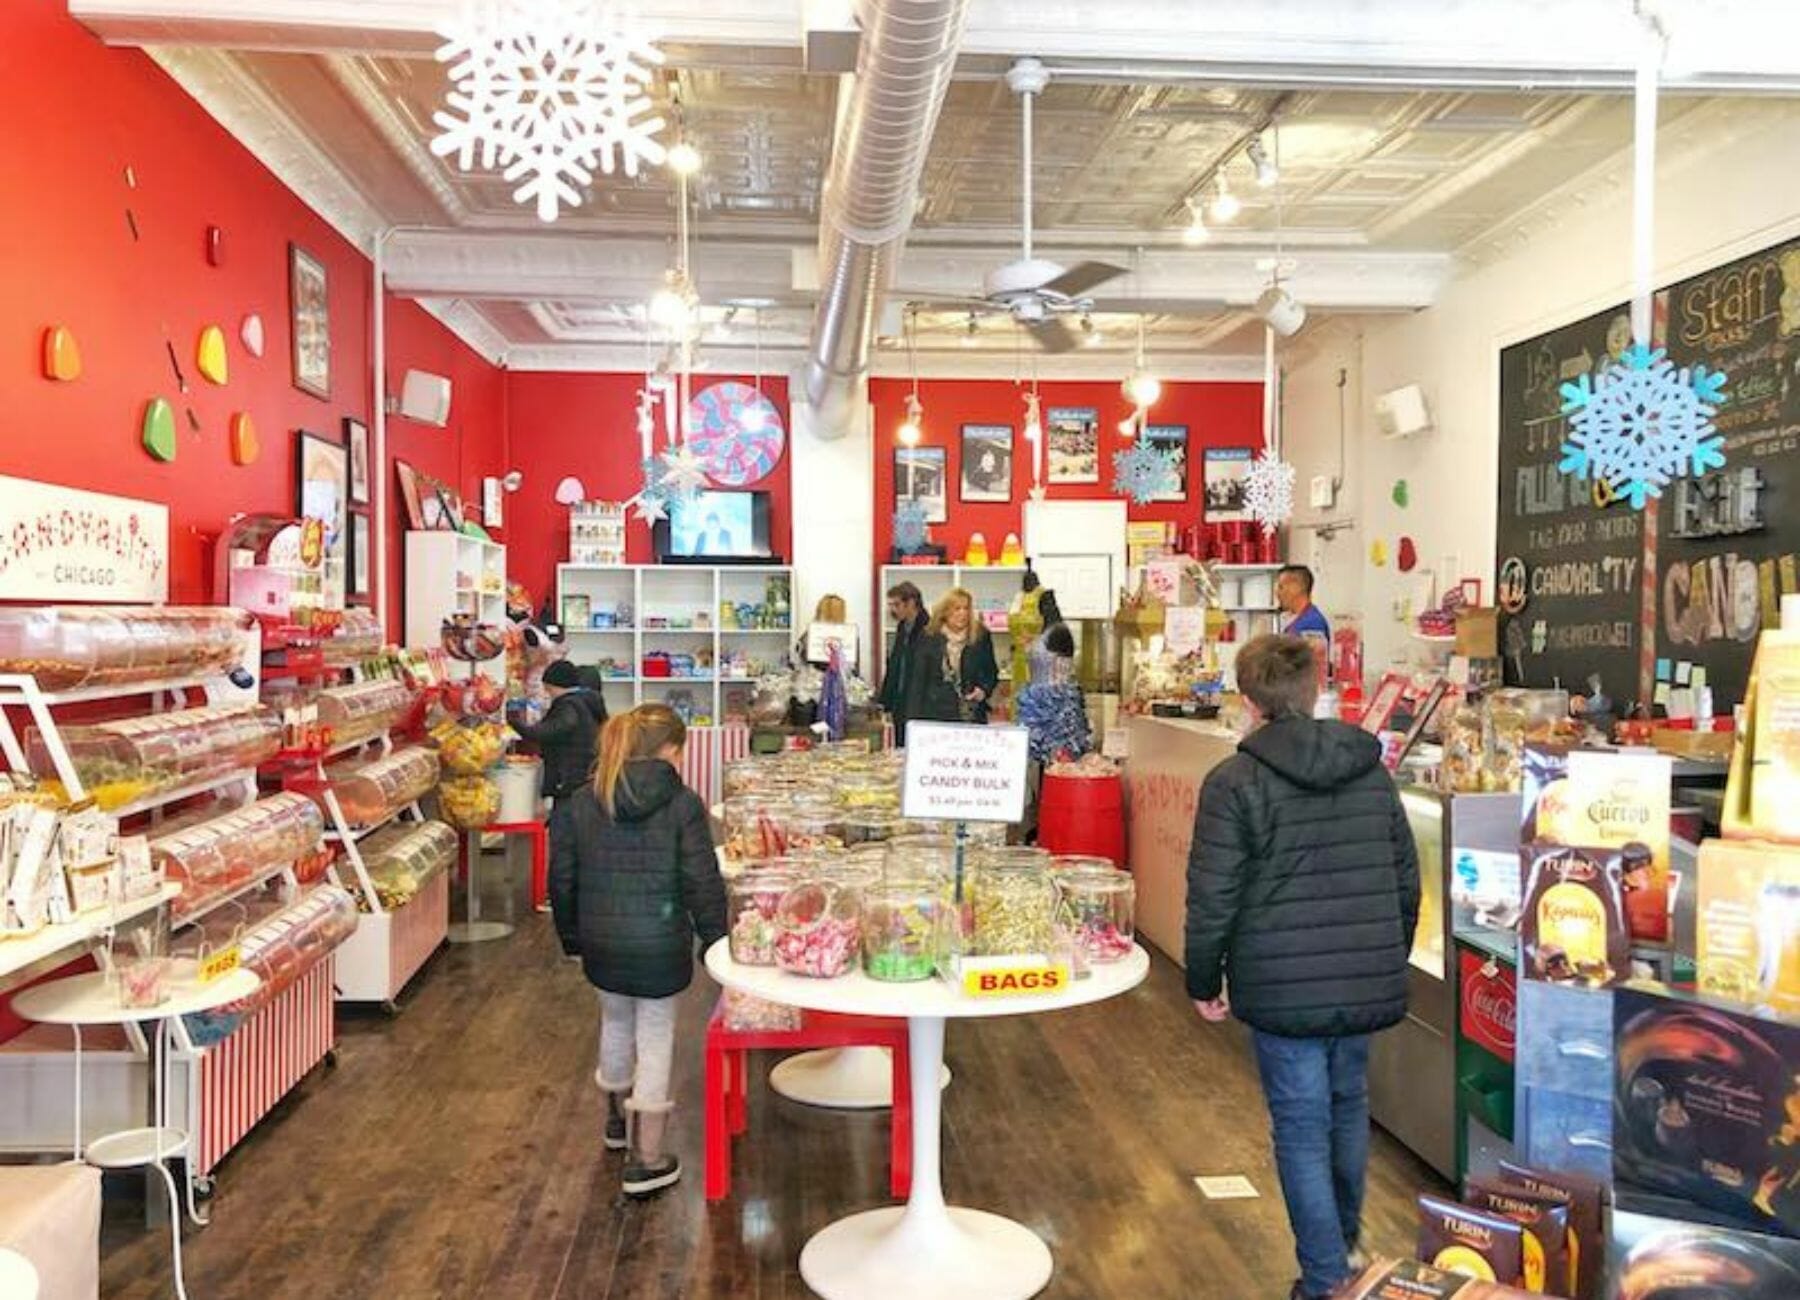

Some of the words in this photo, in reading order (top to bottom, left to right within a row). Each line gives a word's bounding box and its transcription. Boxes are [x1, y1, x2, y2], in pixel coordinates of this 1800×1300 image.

[54, 563, 116, 586] CHICAGO
[930, 757, 960, 769] PICK
[962, 757, 972, 769] &
[975, 759, 999, 770] MIX
[919, 775, 971, 789] CANDY
[973, 778, 1011, 791] BULK
[980, 971, 1059, 991] BAGS
[1523, 1180, 1569, 1200] TURIN
[1488, 1194, 1538, 1216] TURIN
[1442, 1216, 1492, 1242] TURIN
